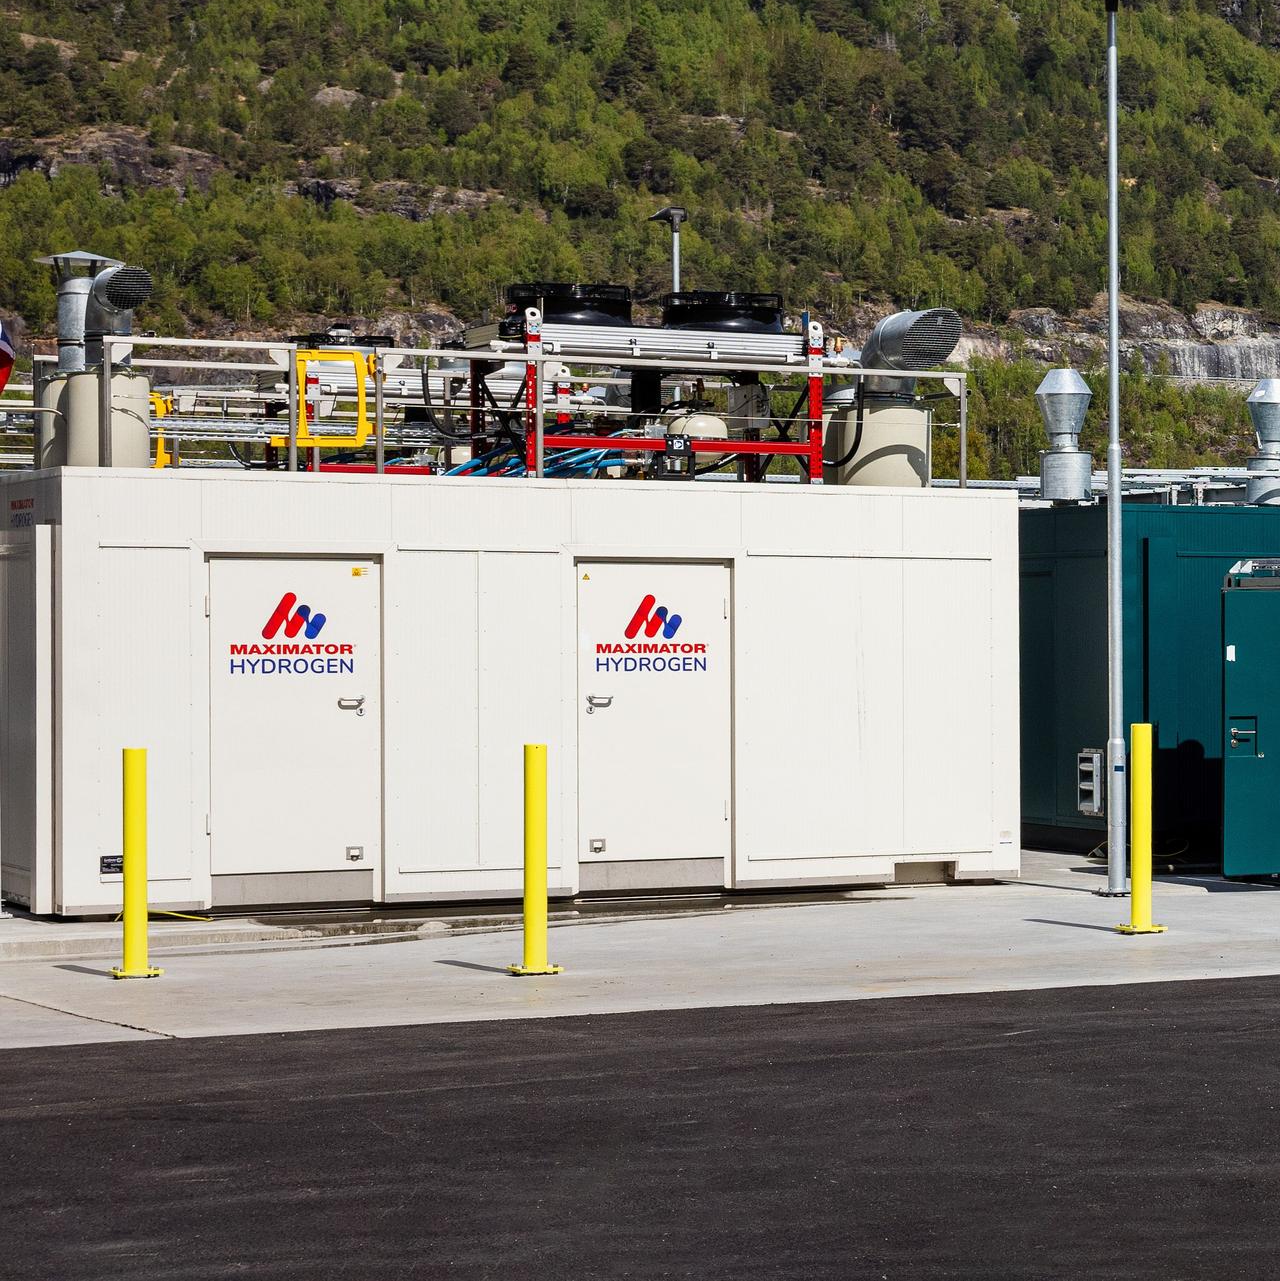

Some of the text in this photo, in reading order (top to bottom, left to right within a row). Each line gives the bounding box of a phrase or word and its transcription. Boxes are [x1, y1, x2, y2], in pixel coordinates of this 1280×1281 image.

[230, 644, 353, 655] MAXIMATOR
[596, 644, 706, 654] MAXIMATOR
[230, 658, 354, 674] HYDROGEN
[596, 657, 707, 672] HYDROGEN
